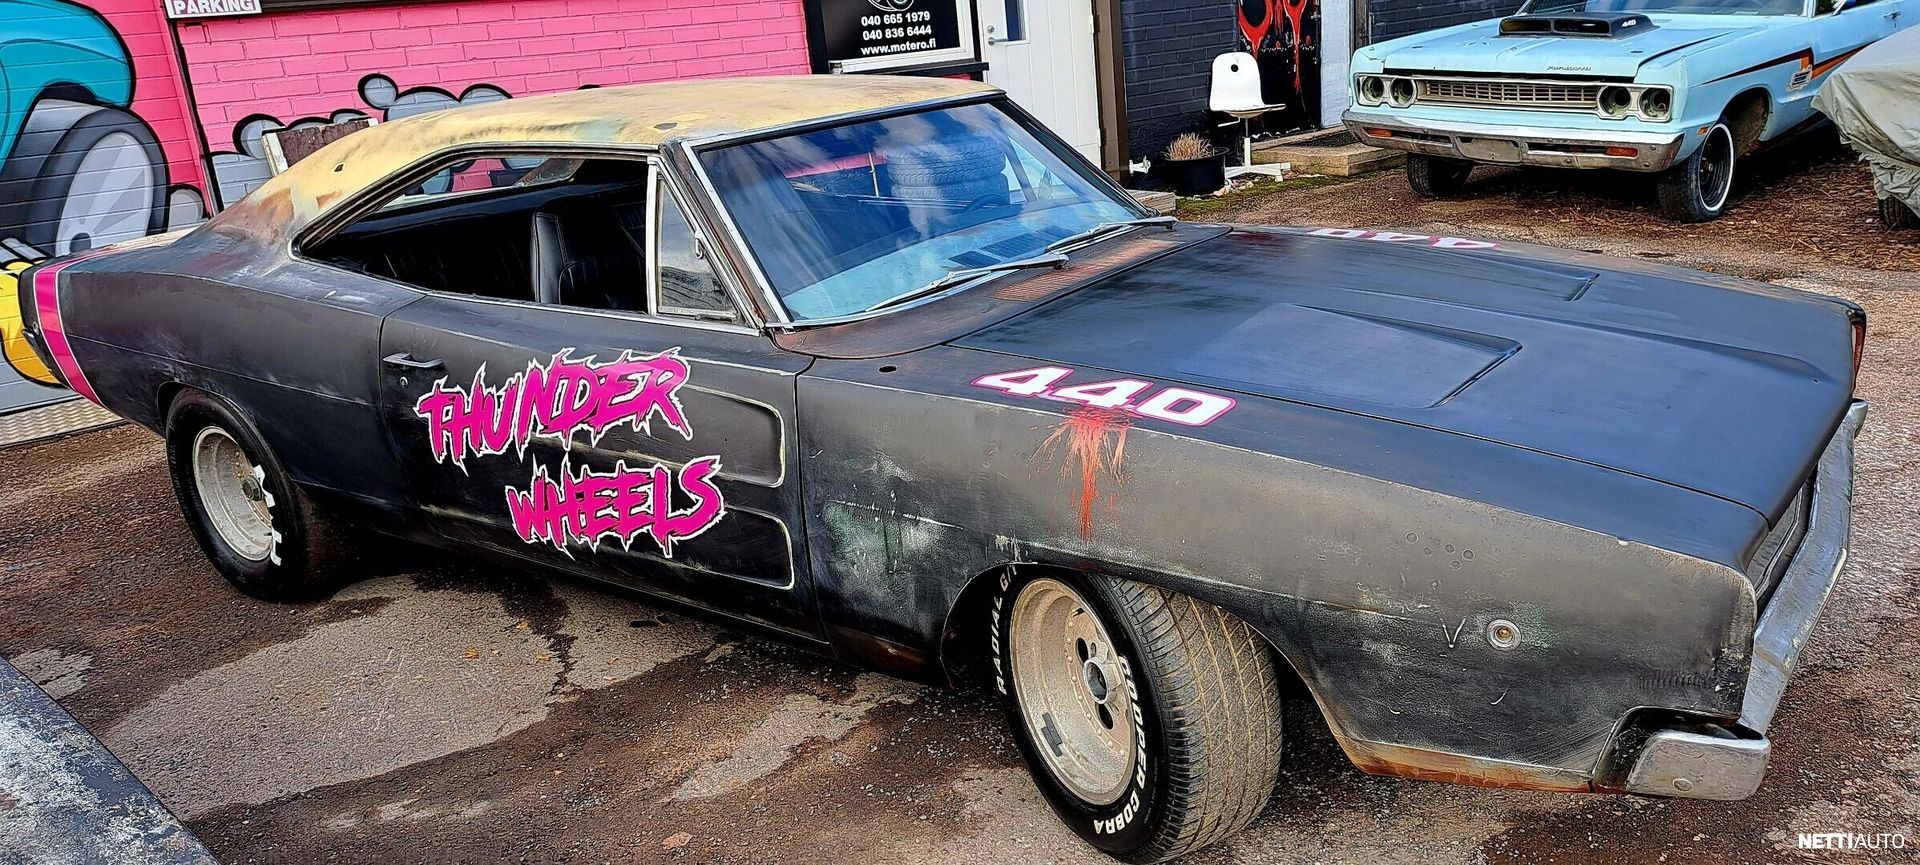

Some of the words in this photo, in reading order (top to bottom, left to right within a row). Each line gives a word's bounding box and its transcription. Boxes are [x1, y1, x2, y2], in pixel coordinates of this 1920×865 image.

[173, 0, 255, 15] PARKING
[861, 15, 881, 26] 040
[883, 13, 903, 24] 665
[905, 11, 930, 22] 1979
[861, 38, 936, 55] www.motero.fi
[862, 29, 882, 40] 040
[885, 27, 904, 38] 836
[906, 25, 932, 36] 6444
[1305, 228, 1500, 250] 440
[413, 346, 694, 477] THUNDER
[970, 366, 1237, 426] 440
[504, 453, 727, 561] WHEELS
[990, 596, 1008, 696] RADIAL
[1117, 655, 1148, 790] COOPER
[1093, 790, 1141, 836] COBRA
